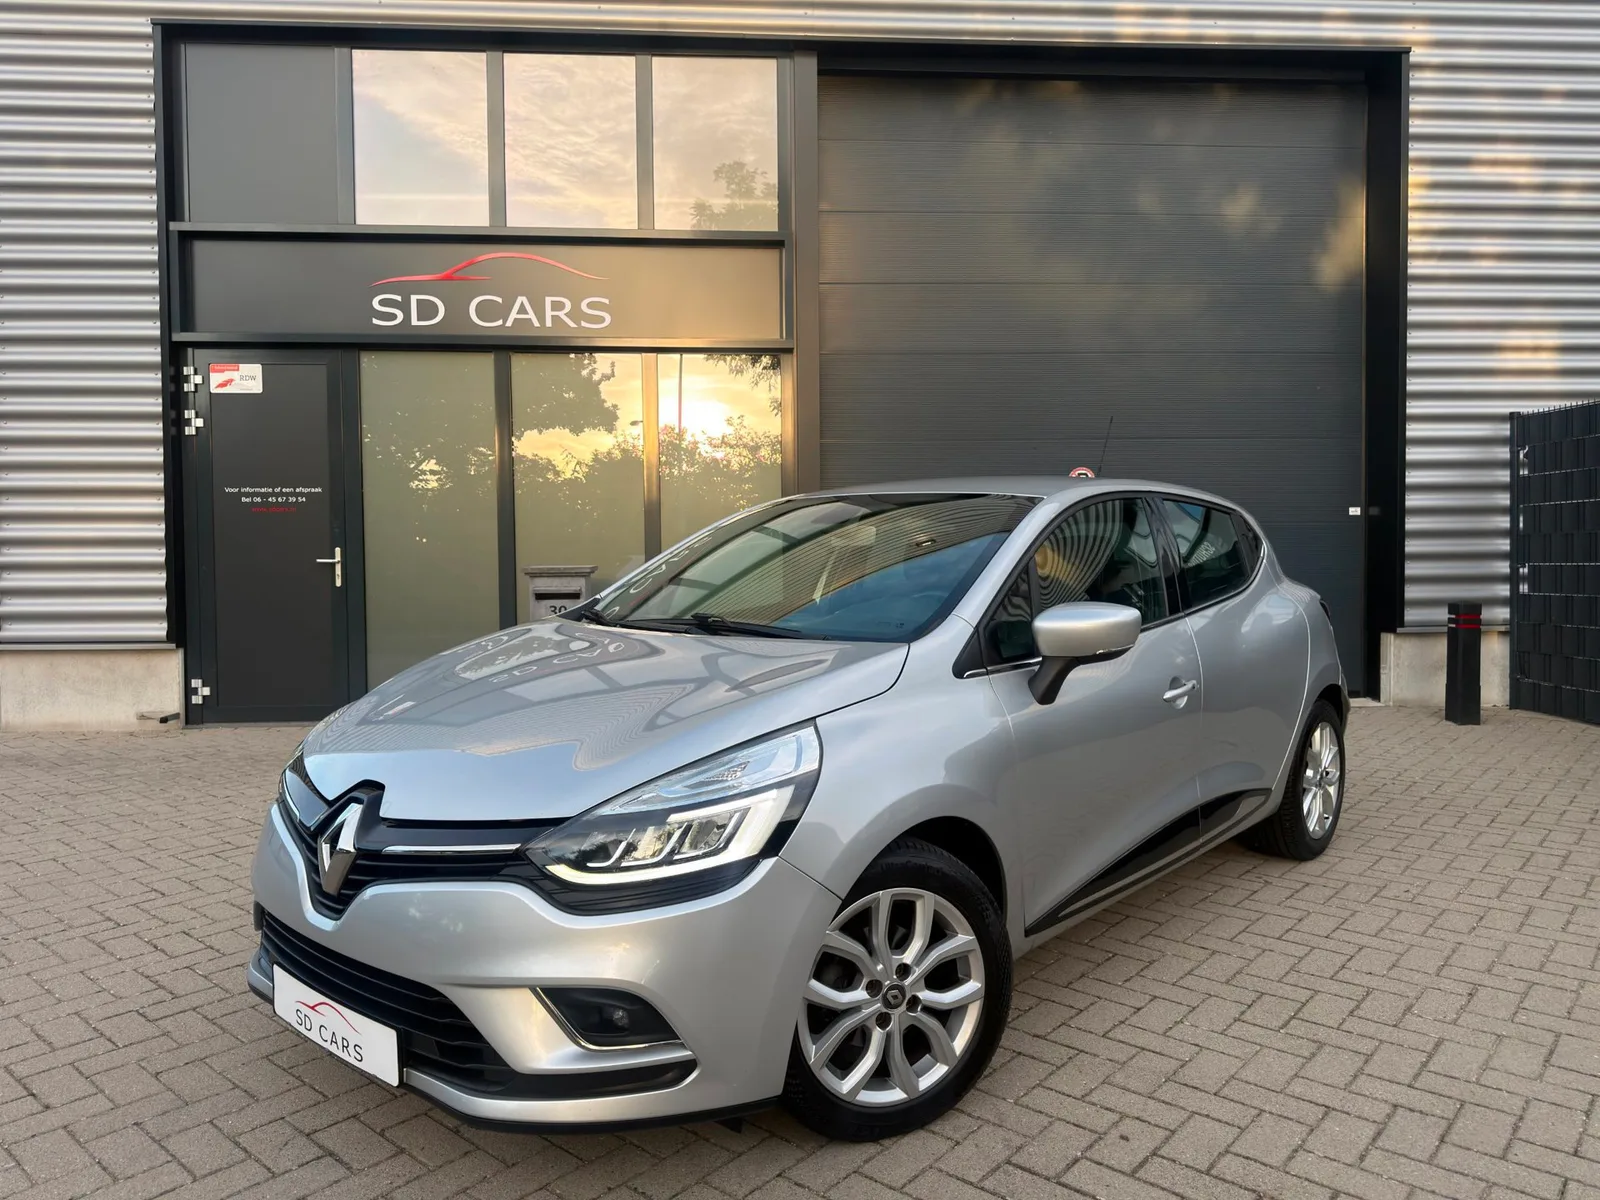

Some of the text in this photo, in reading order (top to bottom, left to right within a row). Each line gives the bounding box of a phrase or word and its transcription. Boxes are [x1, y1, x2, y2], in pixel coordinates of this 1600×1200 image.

[371, 293, 612, 329] SD CARS
[239, 374, 257, 382] RDW
[295, 486, 323, 494] afspraak
[295, 1008, 364, 1063] SD CARS
